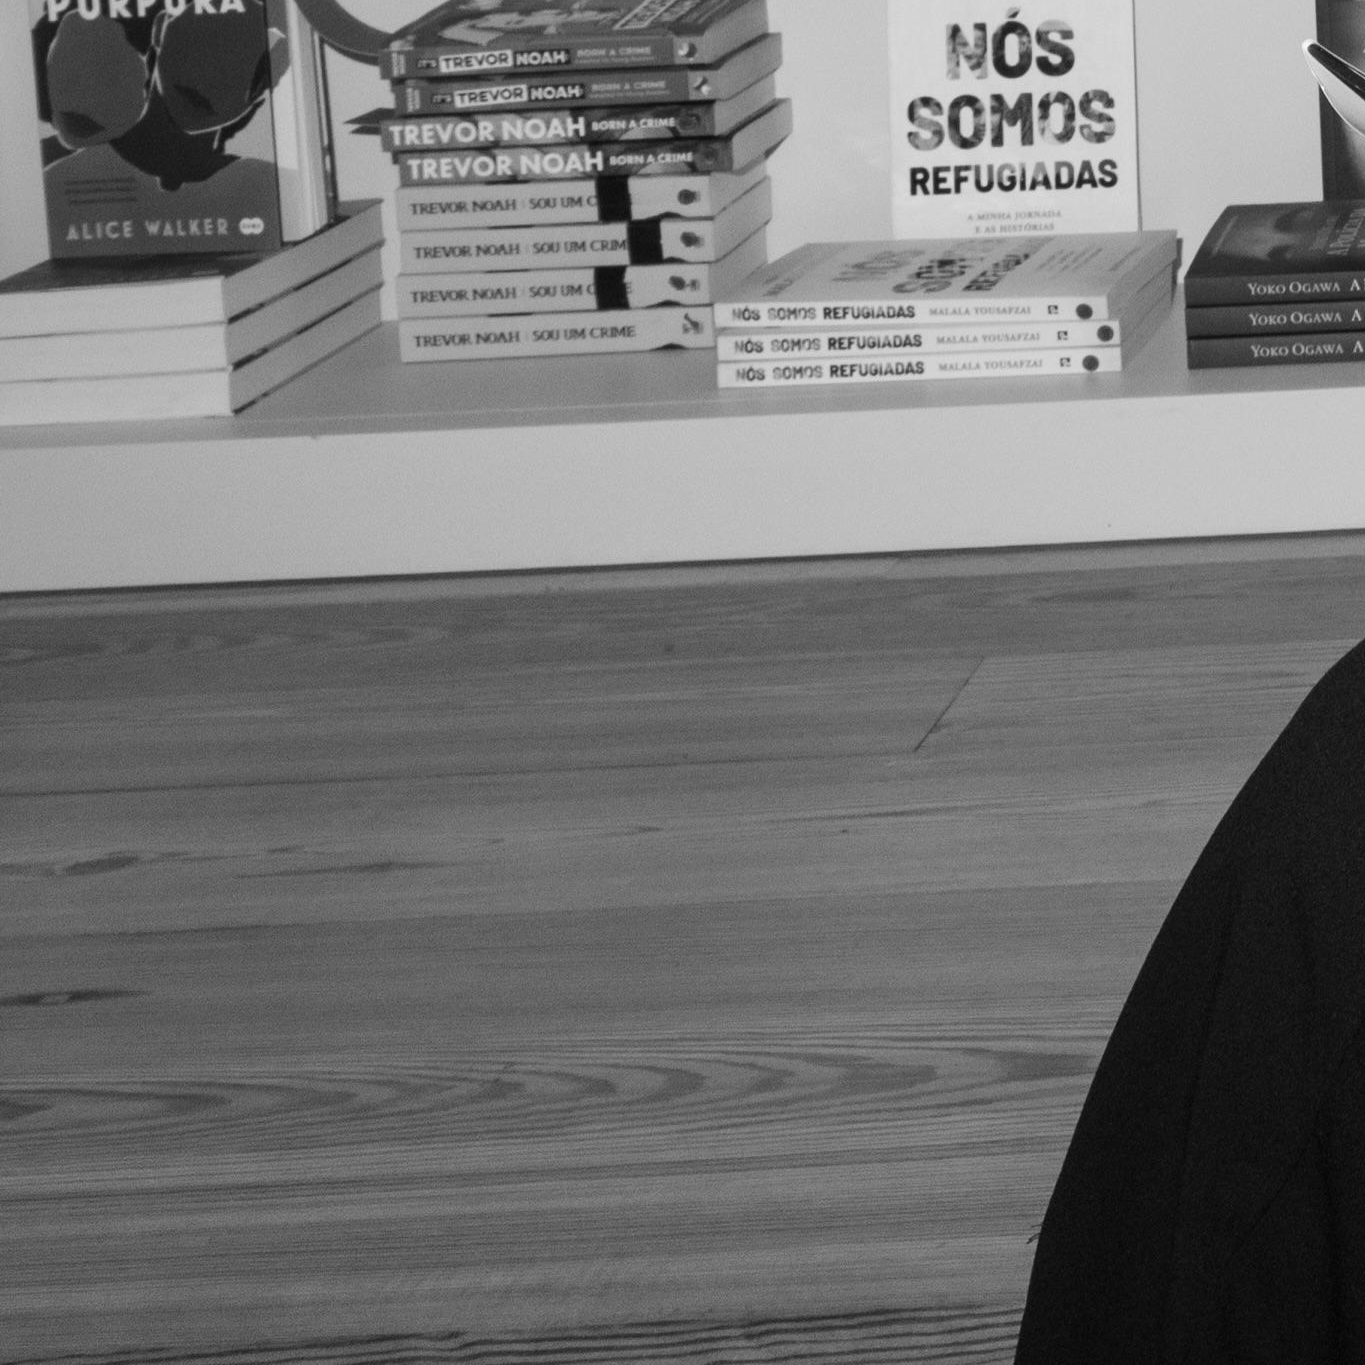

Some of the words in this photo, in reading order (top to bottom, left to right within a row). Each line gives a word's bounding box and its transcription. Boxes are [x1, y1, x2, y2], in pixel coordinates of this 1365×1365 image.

[946, 8, 1075, 80] NÓS
[907, 89, 1116, 151] SOMOS
[910, 160, 1118, 196] REFUGIADAS
[66, 220, 132, 240] ALICE
[145, 218, 228, 236] WALKER
[414, 333, 471, 347] TREVOR
[475, 331, 520, 344] NOAH
[532, 330, 560, 341] SOU
[564, 328, 586, 339] UM
[589, 326, 634, 338] CRIME
